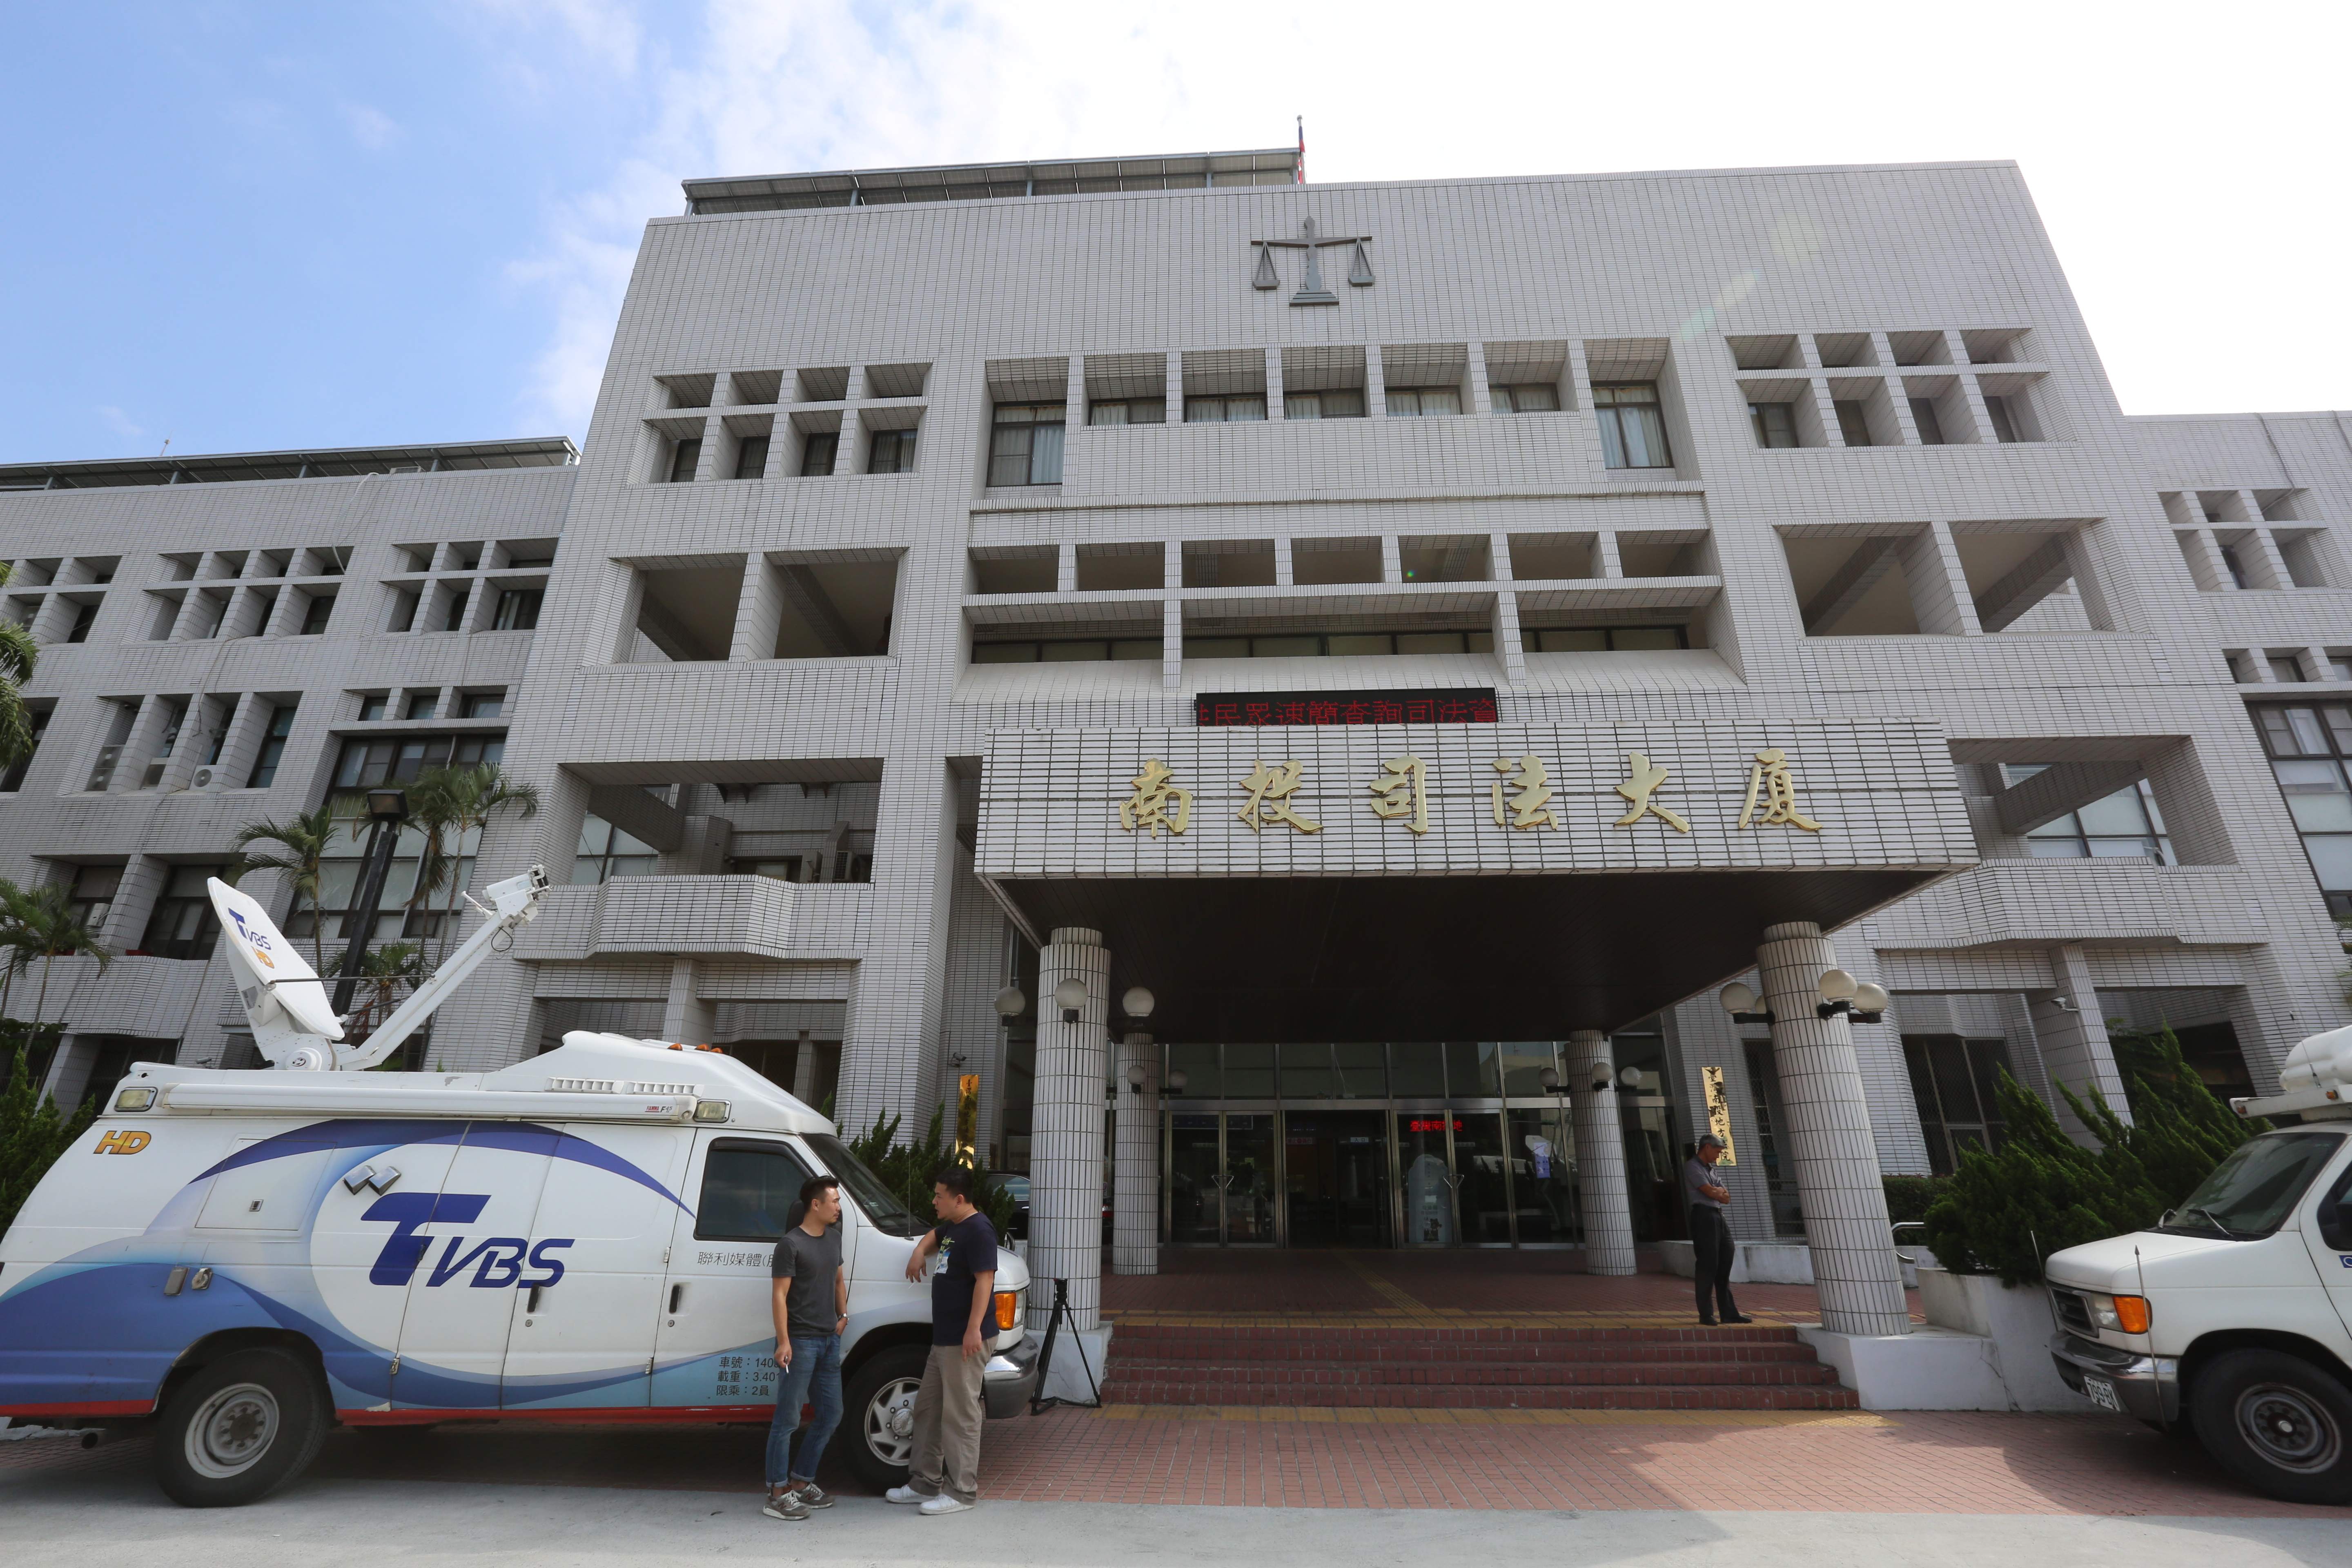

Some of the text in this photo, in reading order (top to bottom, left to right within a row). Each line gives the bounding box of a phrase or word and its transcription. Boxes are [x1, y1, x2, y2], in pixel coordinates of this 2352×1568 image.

[1120, 749, 1823, 840] 南投司法大廈
[228, 907, 271, 950] TVBS
[251, 945, 274, 969] HD
[93, 1130, 151, 1155] HD
[361, 1192, 575, 1289] TVBS
